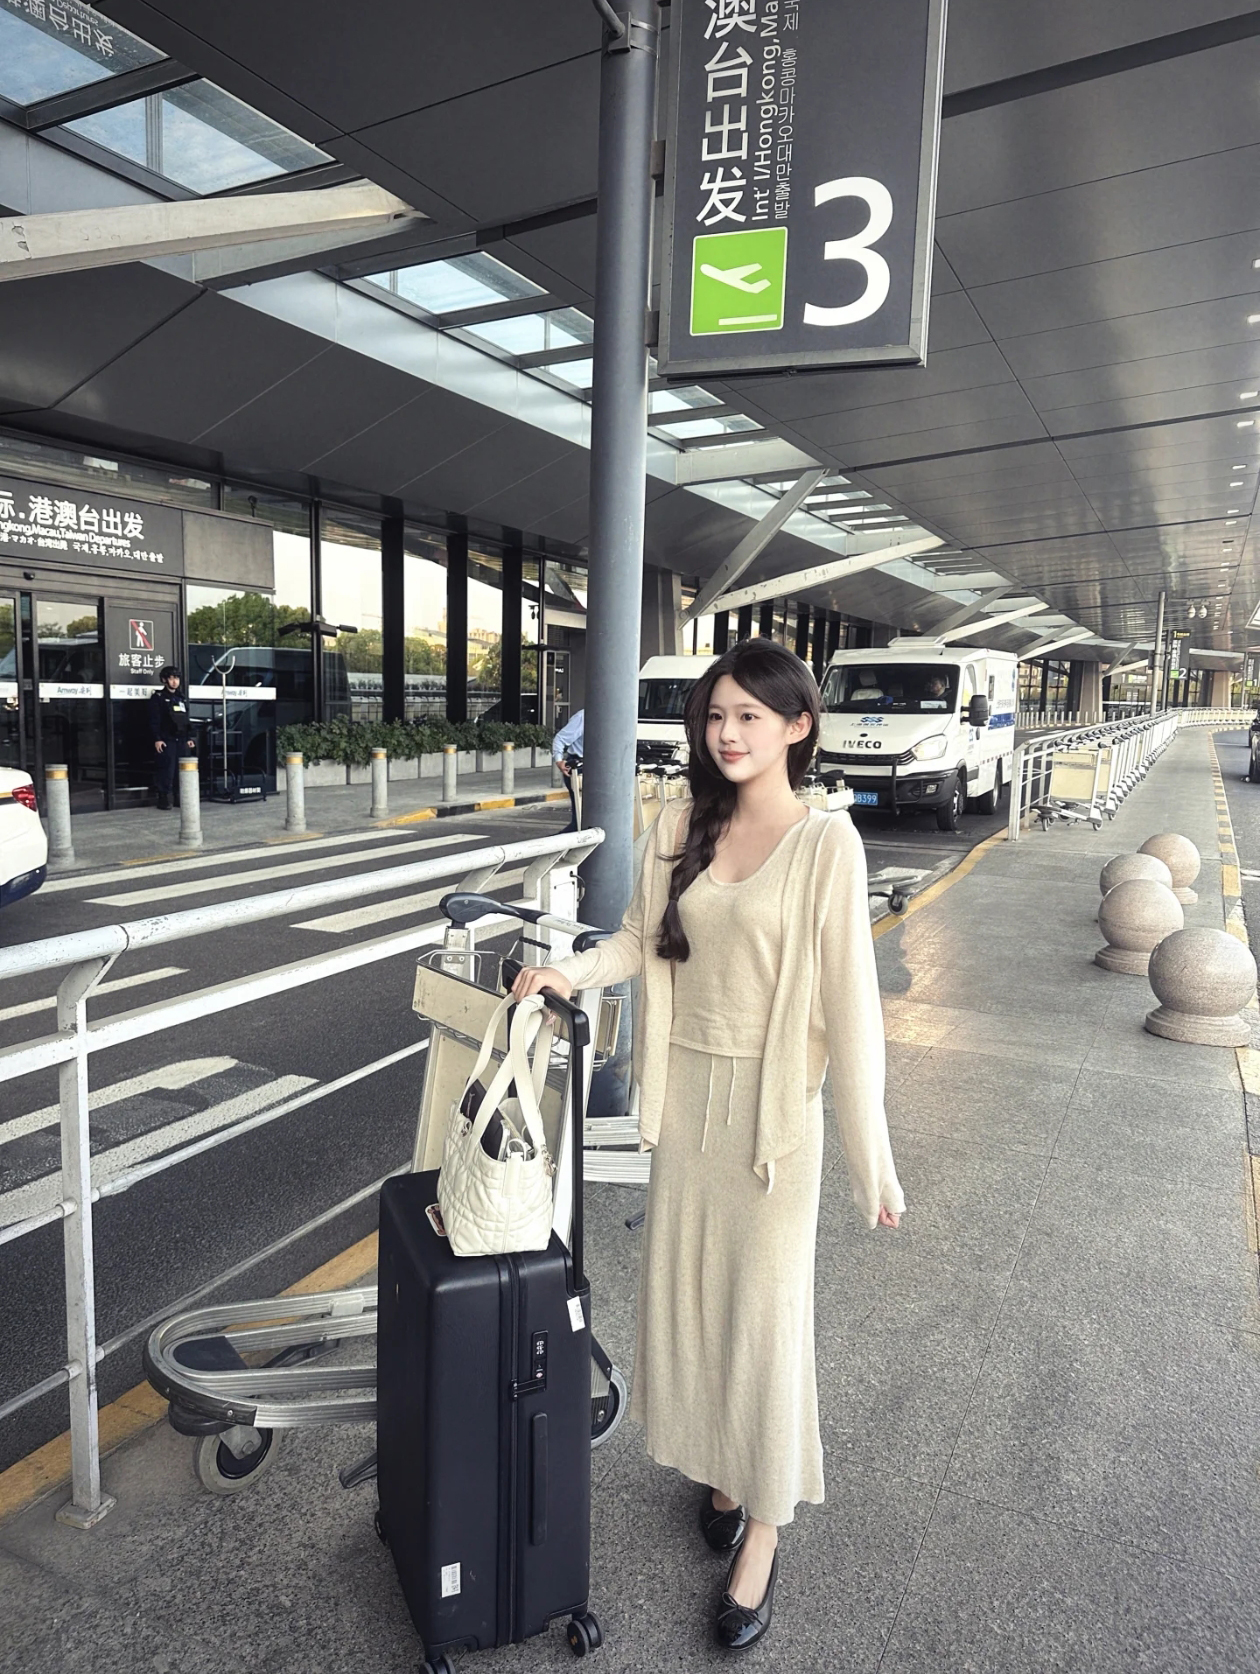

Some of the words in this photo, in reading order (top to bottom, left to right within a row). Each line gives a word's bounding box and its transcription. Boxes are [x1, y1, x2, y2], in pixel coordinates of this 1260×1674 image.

[803, 176, 894, 327] 3
[118, 653, 166, 668] 旅客止步
[1178, 667, 1188, 679] 2
[842, 740, 882, 749] IVECO
